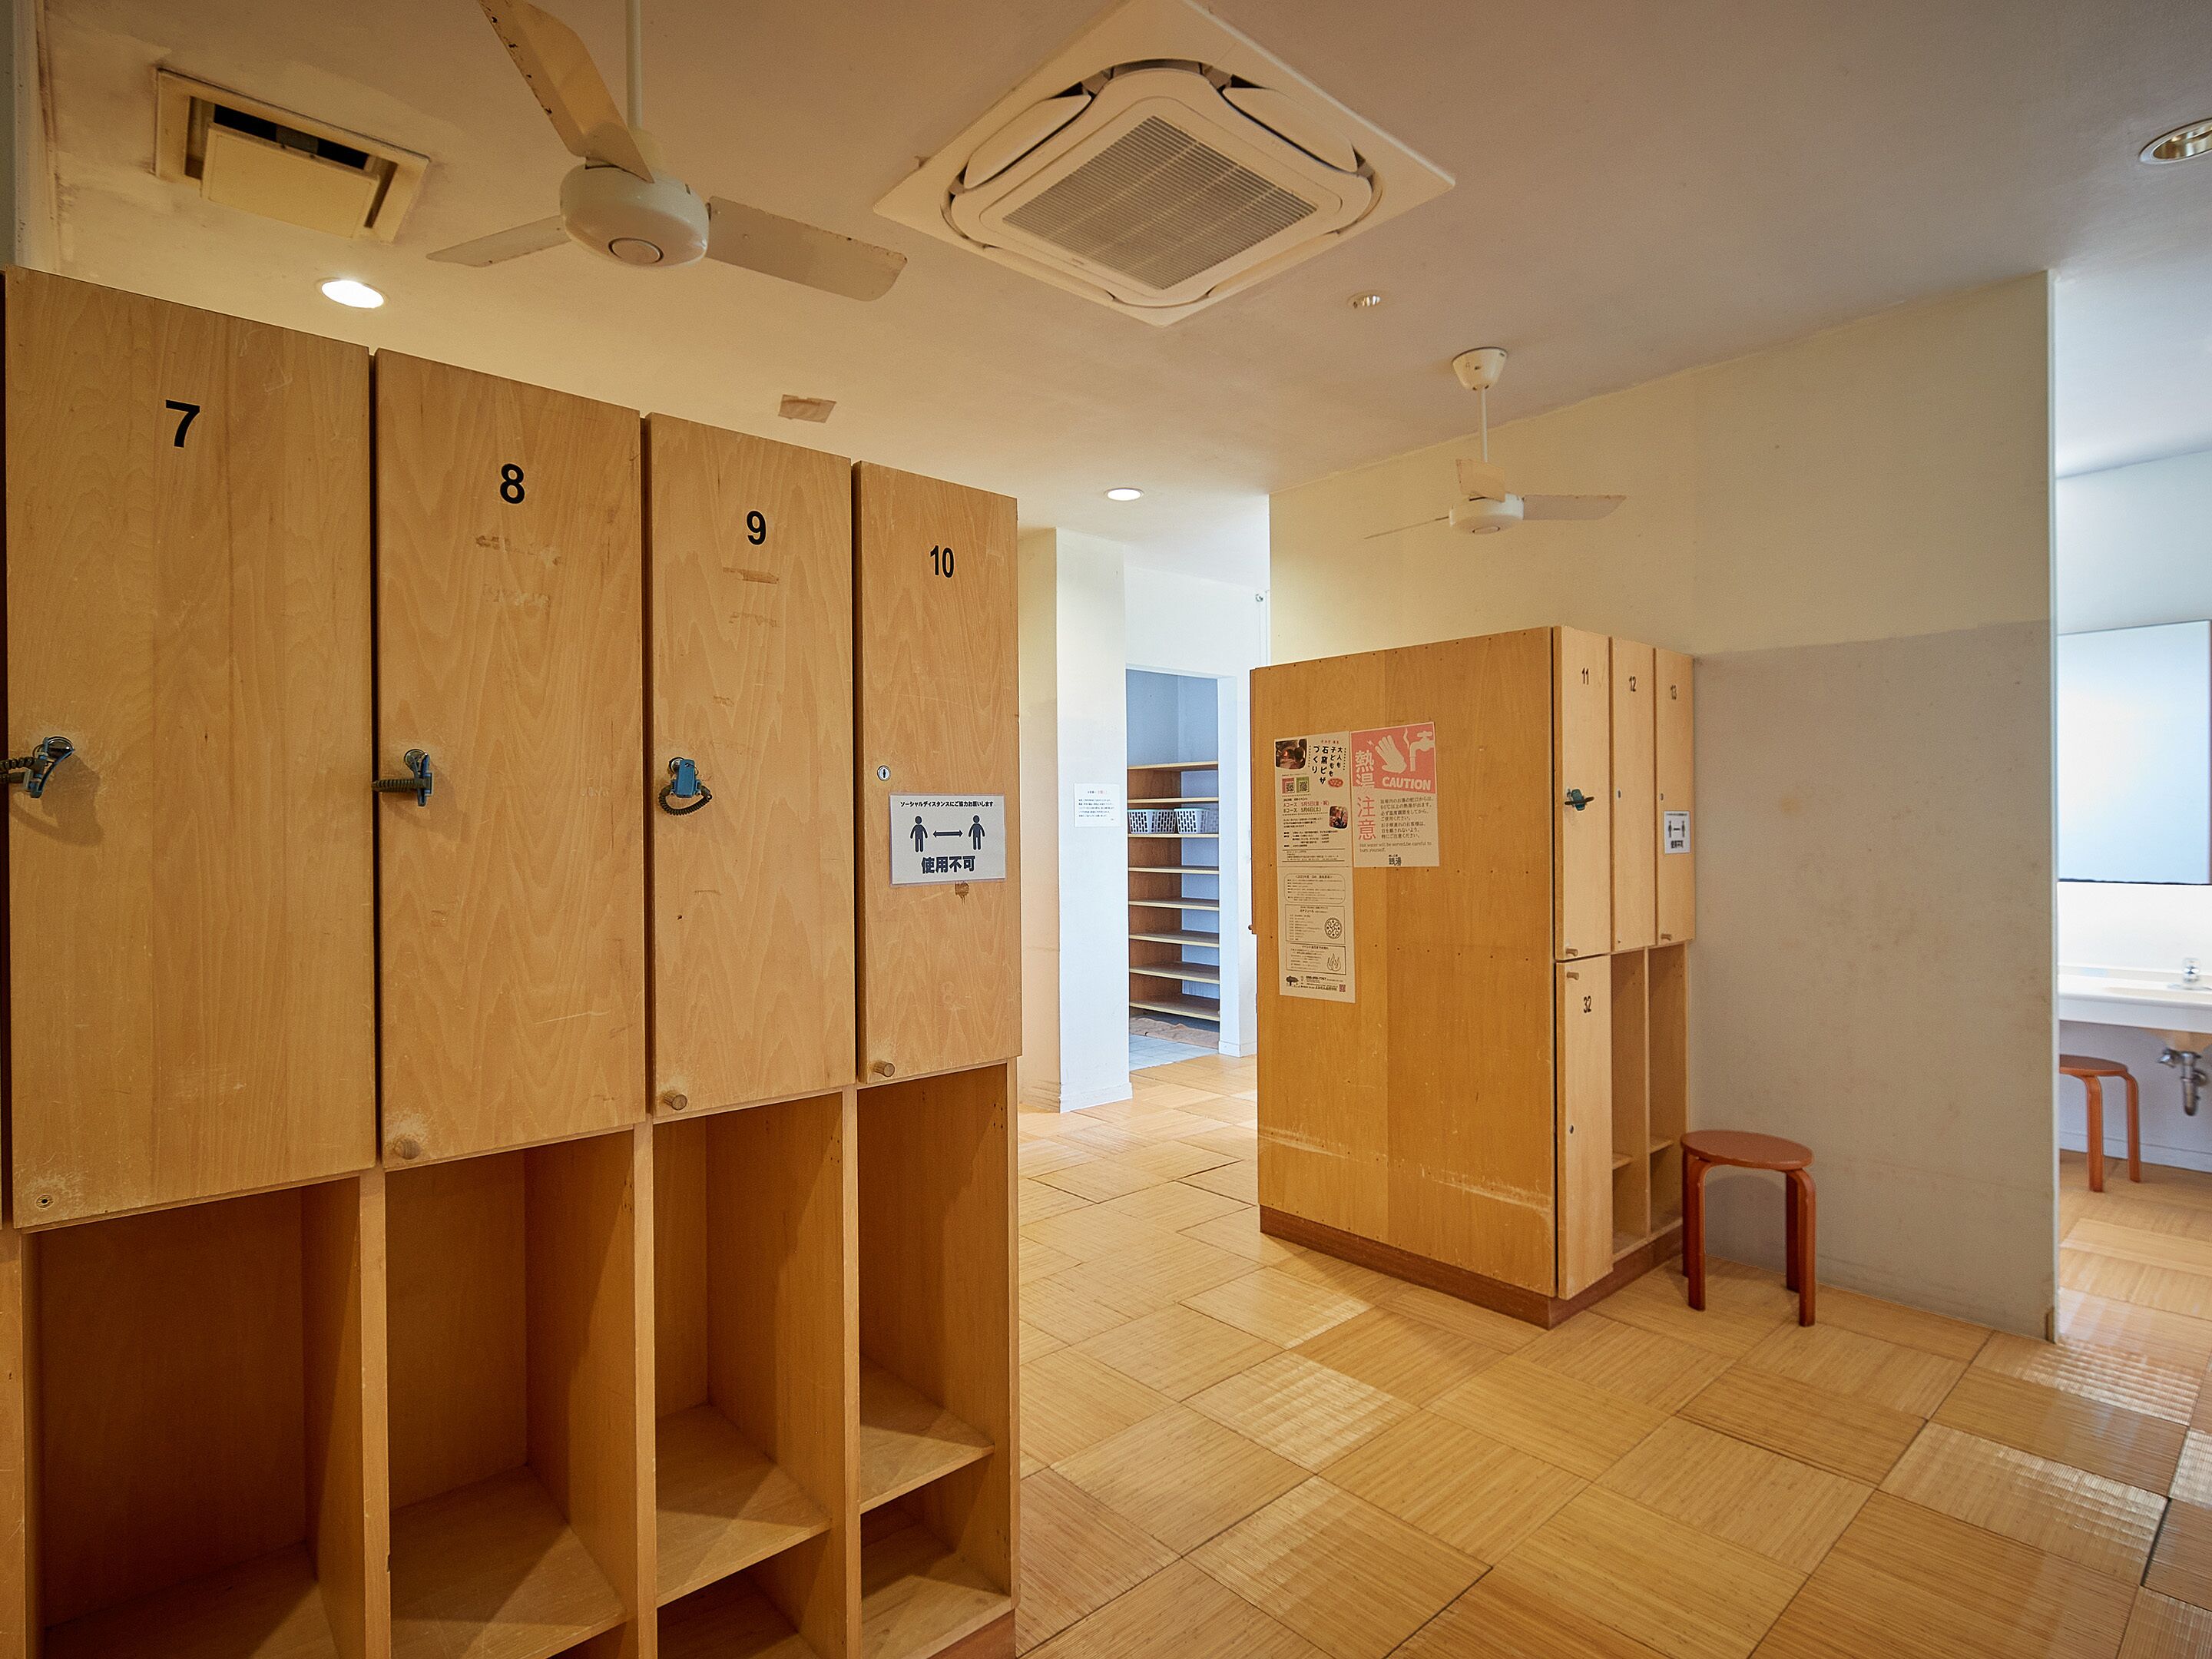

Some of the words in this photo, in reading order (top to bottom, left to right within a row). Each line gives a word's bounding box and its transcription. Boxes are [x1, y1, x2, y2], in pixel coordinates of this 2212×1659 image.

[166, 399, 200, 448] 7
[500, 464, 525, 505] 8
[746, 511, 767, 545] 9
[930, 545, 955, 578] 10
[1581, 667, 1590, 685] 11
[1628, 676, 1637, 693] 12
[1670, 684, 1677, 700] 13
[1312, 745, 1320, 773] づくり
[1355, 750, 1376, 840] 熱湯注意
[1382, 777, 1432, 790] CAUTION
[921, 855, 976, 874] 使用不可
[1583, 995, 1592, 1014] 32
